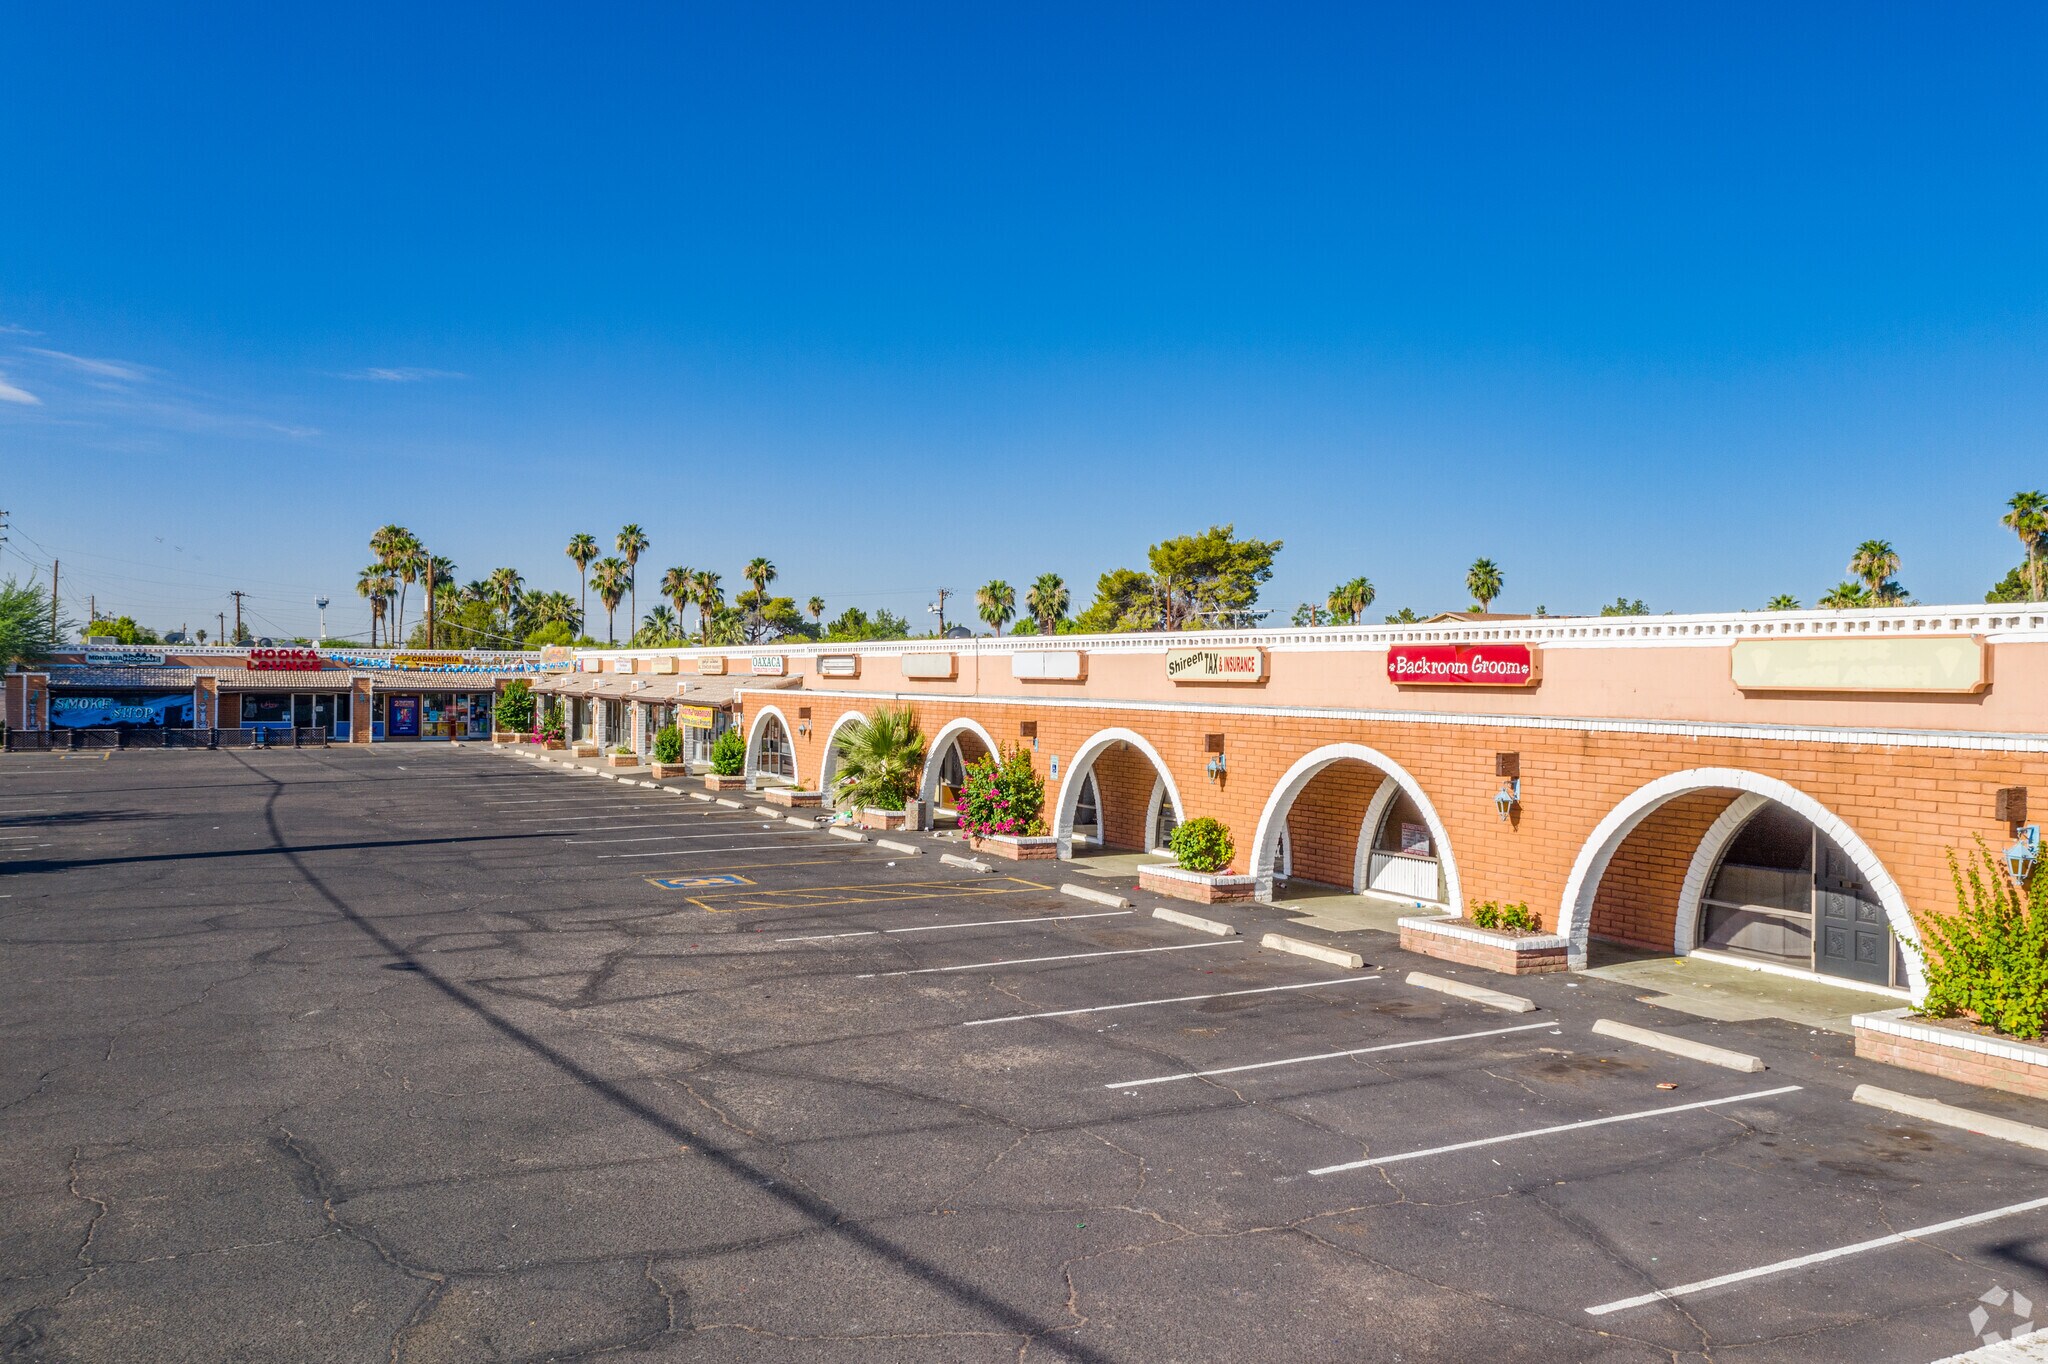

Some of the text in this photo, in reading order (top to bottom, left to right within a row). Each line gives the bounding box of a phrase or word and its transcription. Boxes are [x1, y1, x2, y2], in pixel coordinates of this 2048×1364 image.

[251, 649, 318, 660] HOOKA
[247, 660, 322, 671] LOUNGE
[752, 656, 781, 667] OAXACA
[1169, 651, 1254, 675] Shireen TAX & INSURANCE
[1396, 654, 1521, 675] Backroom Groom
[54, 697, 114, 711] SMOKE
[111, 706, 155, 719] SHOP
